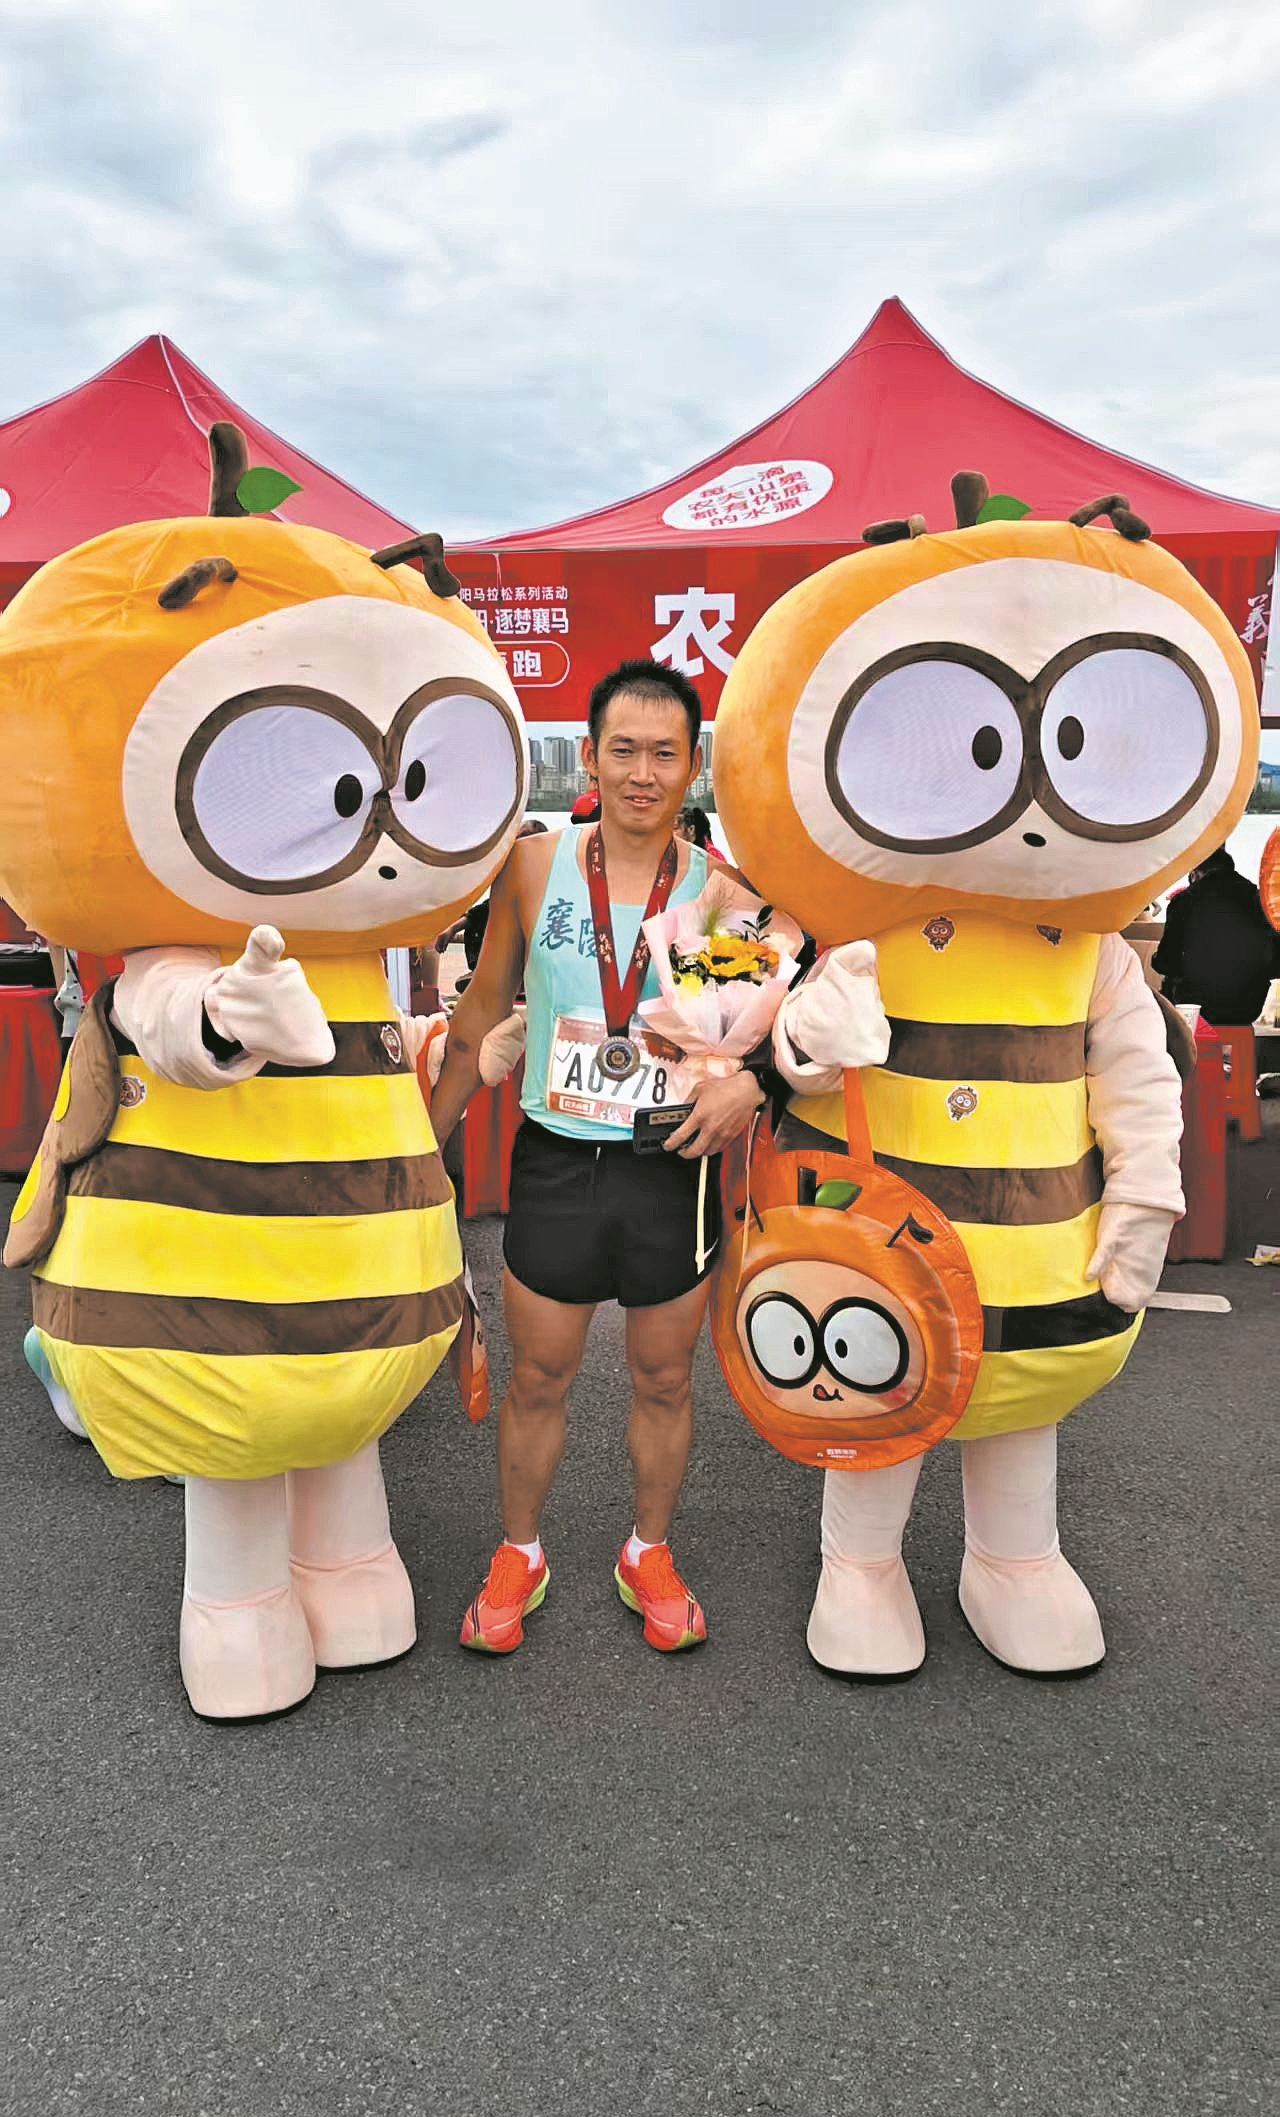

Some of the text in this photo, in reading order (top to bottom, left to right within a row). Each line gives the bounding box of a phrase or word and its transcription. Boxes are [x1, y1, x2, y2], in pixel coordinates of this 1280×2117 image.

[688, 471, 806, 511] 农夫山泉
[700, 465, 784, 498] 每一滴
[691, 482, 812, 520] 都有优质
[711, 497, 802, 526] 的水源
[650, 587, 736, 677] 农
[499, 650, 542, 677] 跑
